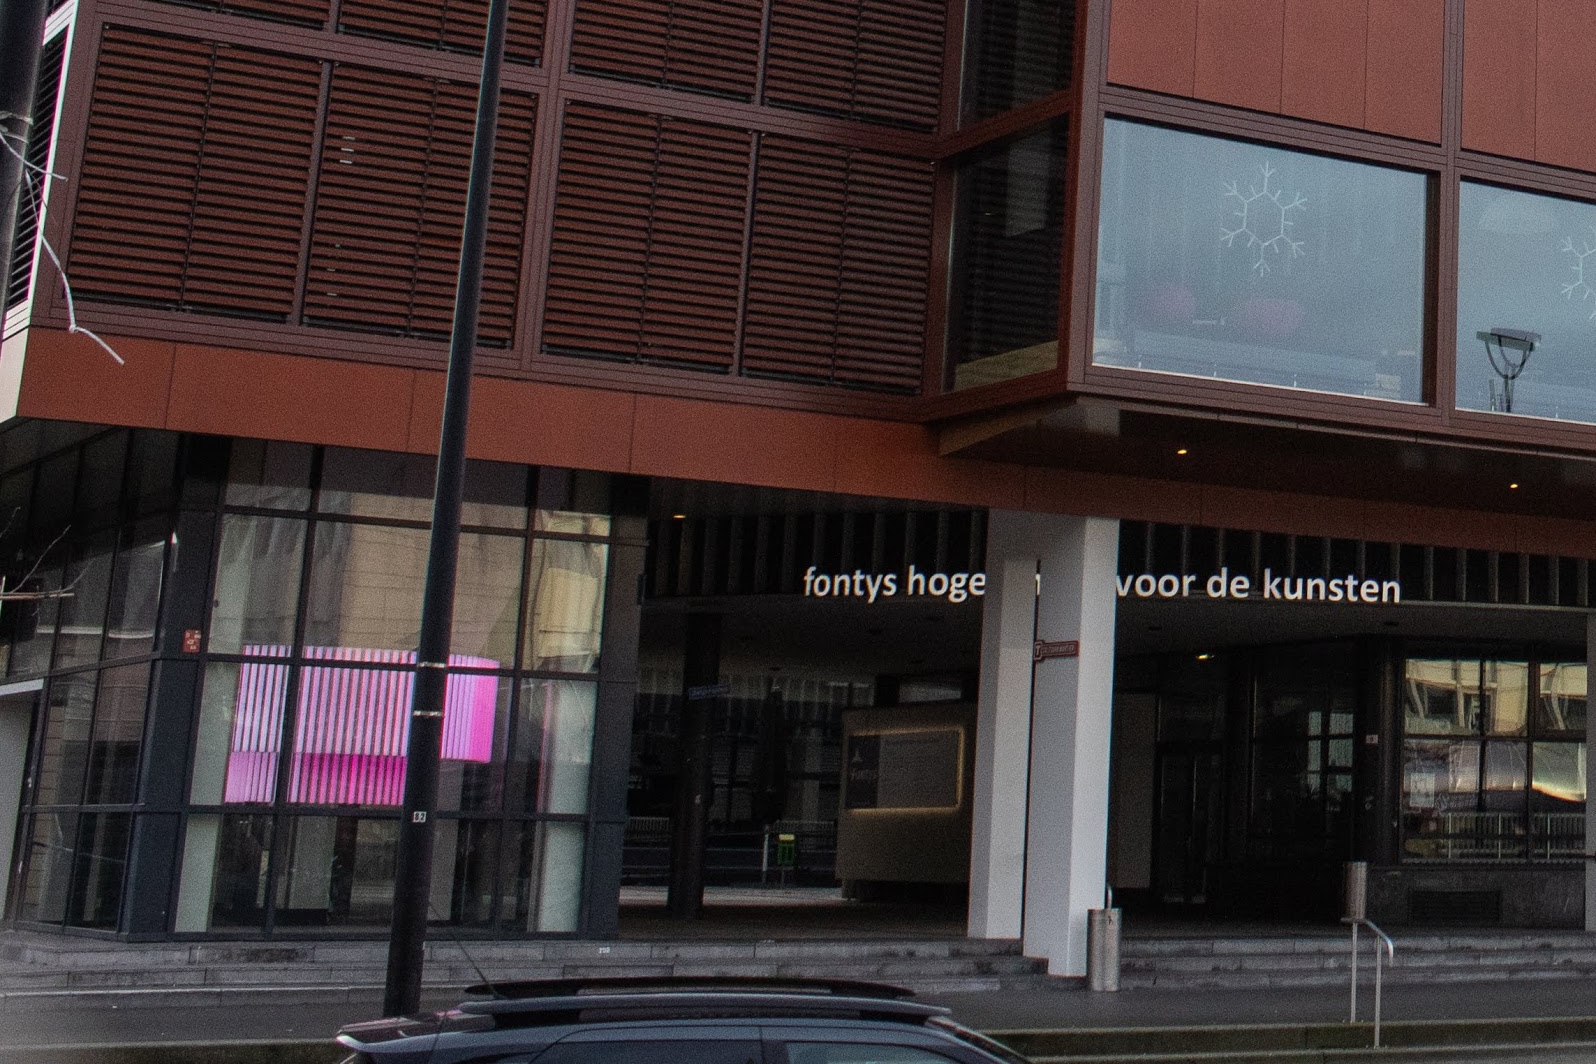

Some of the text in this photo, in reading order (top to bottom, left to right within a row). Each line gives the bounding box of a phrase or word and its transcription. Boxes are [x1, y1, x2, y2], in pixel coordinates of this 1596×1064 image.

[804, 565, 1400, 604] fontys hoge voor de kunsten
